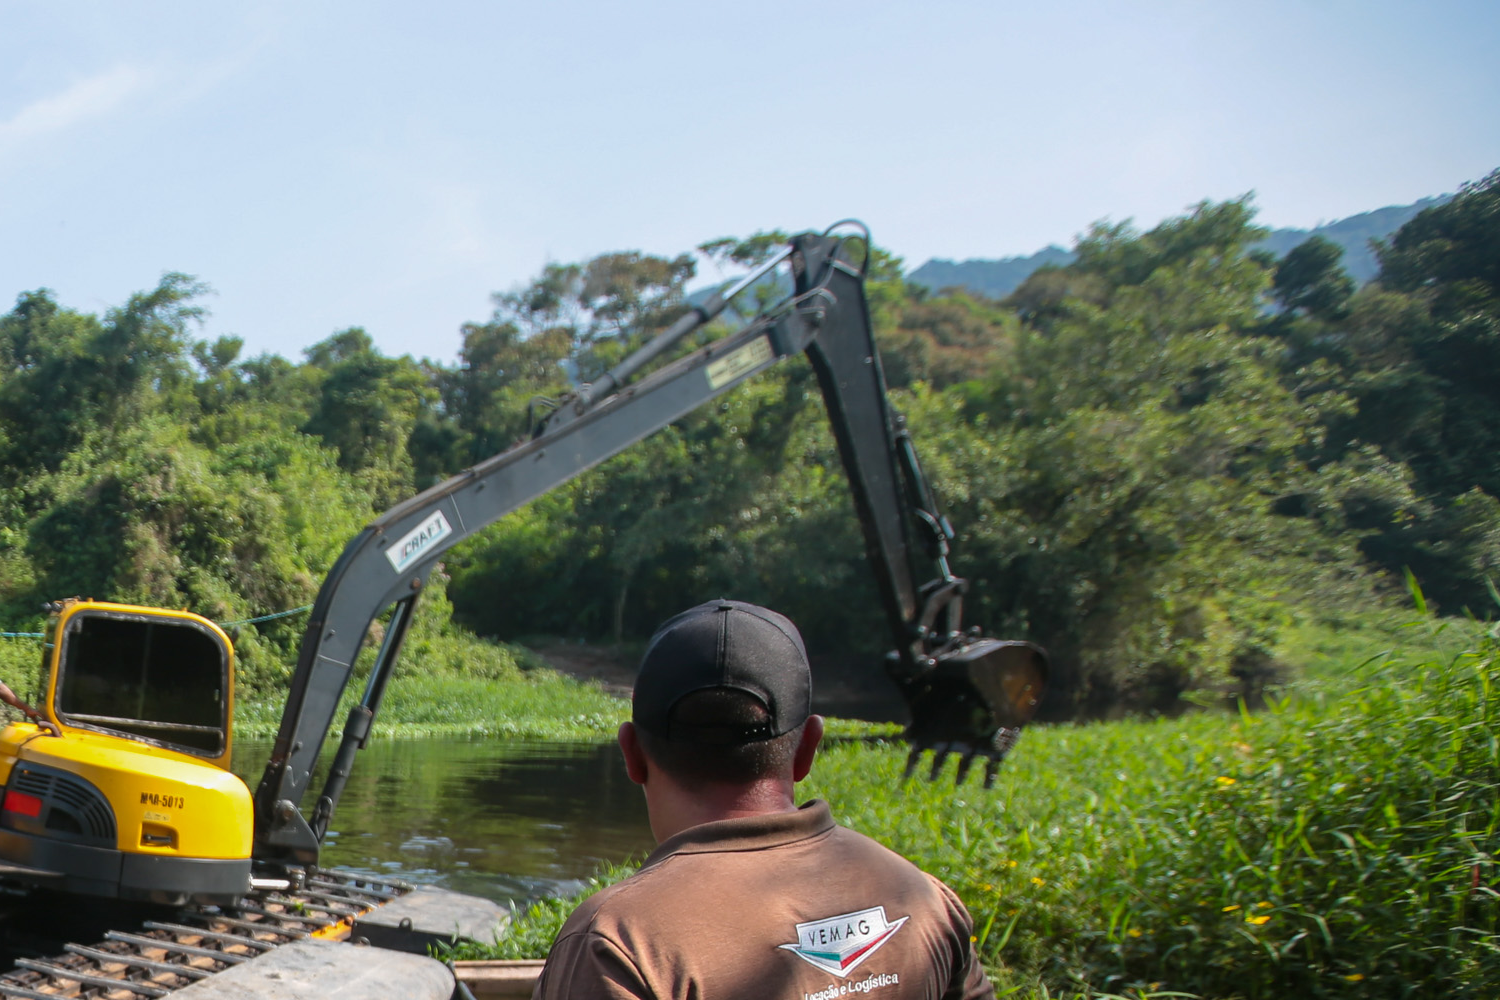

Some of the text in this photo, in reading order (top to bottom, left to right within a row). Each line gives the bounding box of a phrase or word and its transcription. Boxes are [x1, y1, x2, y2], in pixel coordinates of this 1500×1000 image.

[808, 920, 871, 947] VEMAG
[841, 986, 847, 995] e
[848, 973, 899, 993] Logística
